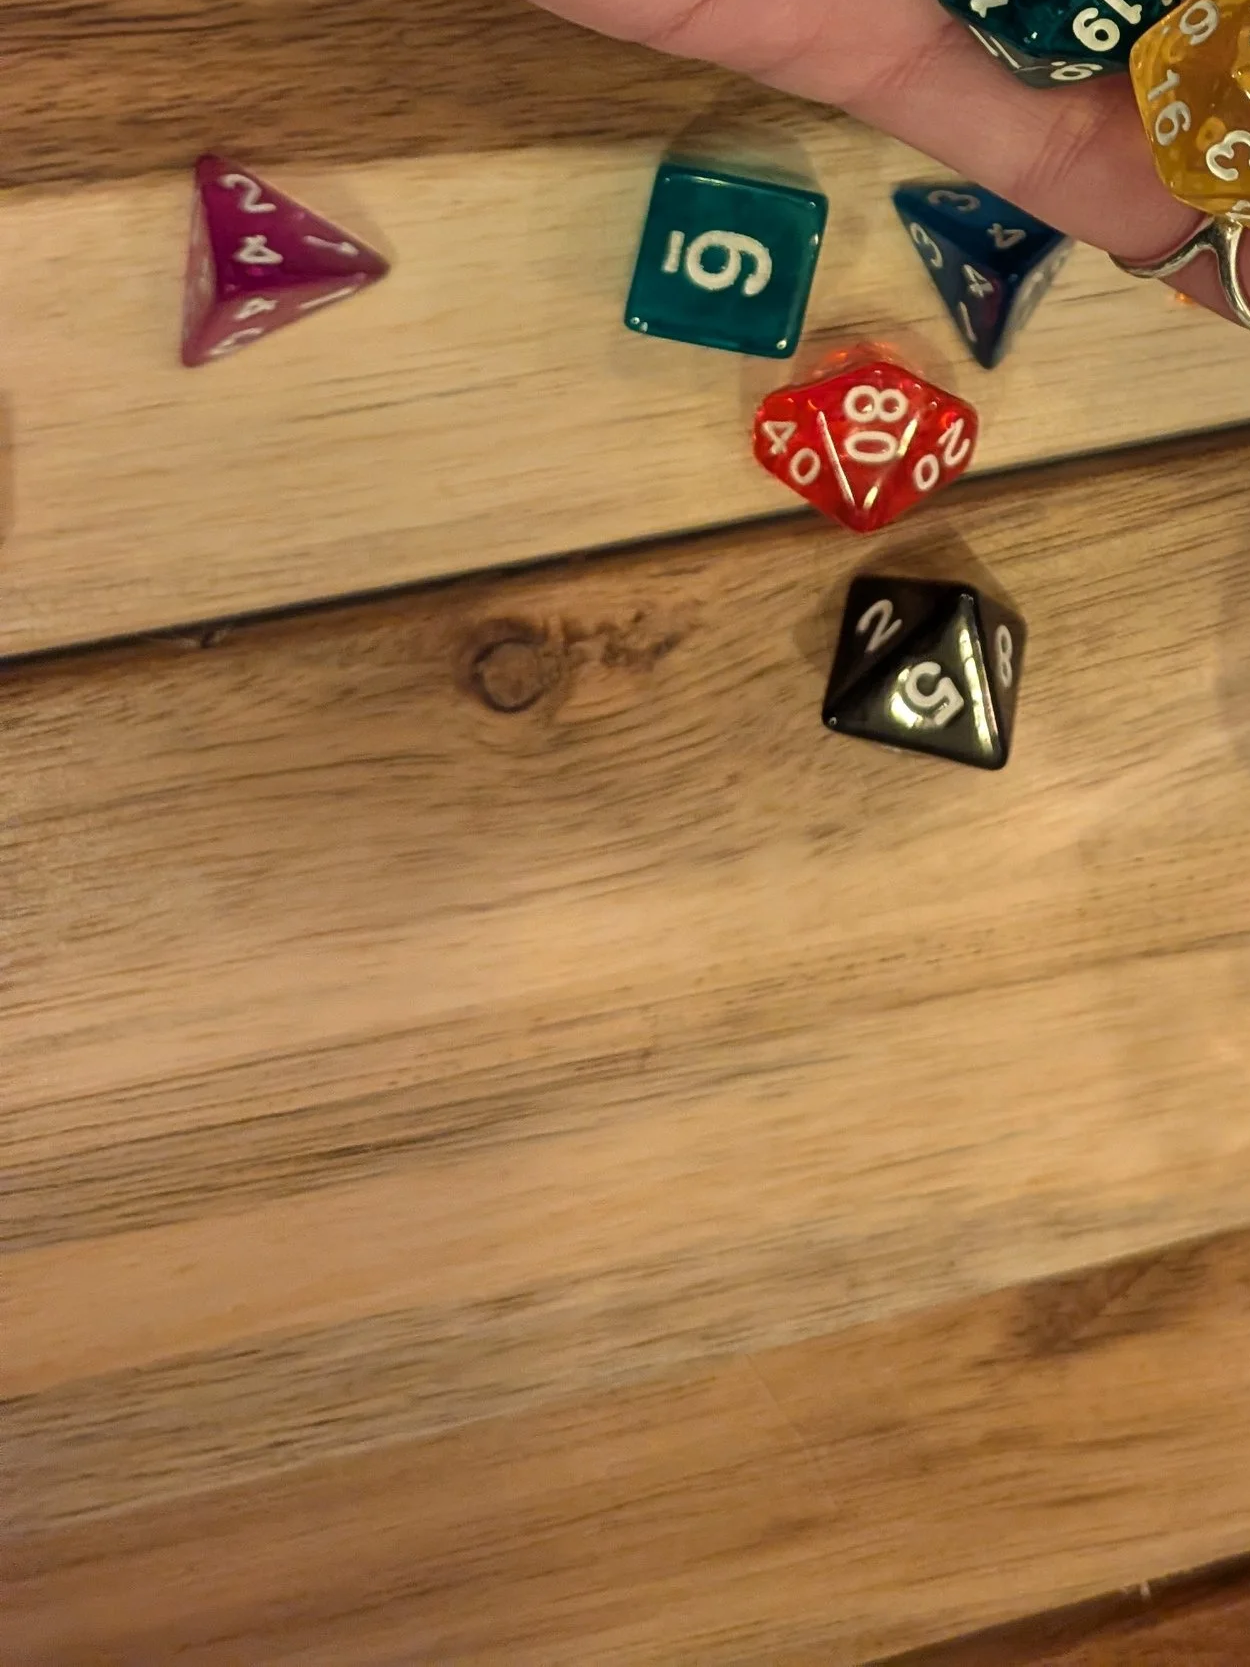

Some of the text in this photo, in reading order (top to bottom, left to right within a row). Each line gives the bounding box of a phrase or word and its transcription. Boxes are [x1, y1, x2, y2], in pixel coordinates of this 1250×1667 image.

[219, 173, 277, 214] 2
[927, 189, 980, 212] 3
[233, 234, 284, 264] 4
[303, 235, 359, 257] 1
[910, 222, 944, 268] 3
[986, 222, 1027, 249] 4
[963, 263, 994, 298] 4
[843, 385, 909, 463] 80
[761, 420, 821, 486] 40
[913, 418, 971, 492] 20
[855, 599, 903, 654] 2
[994, 624, 1013, 688] 8
[905, 661, 965, 726] 5
